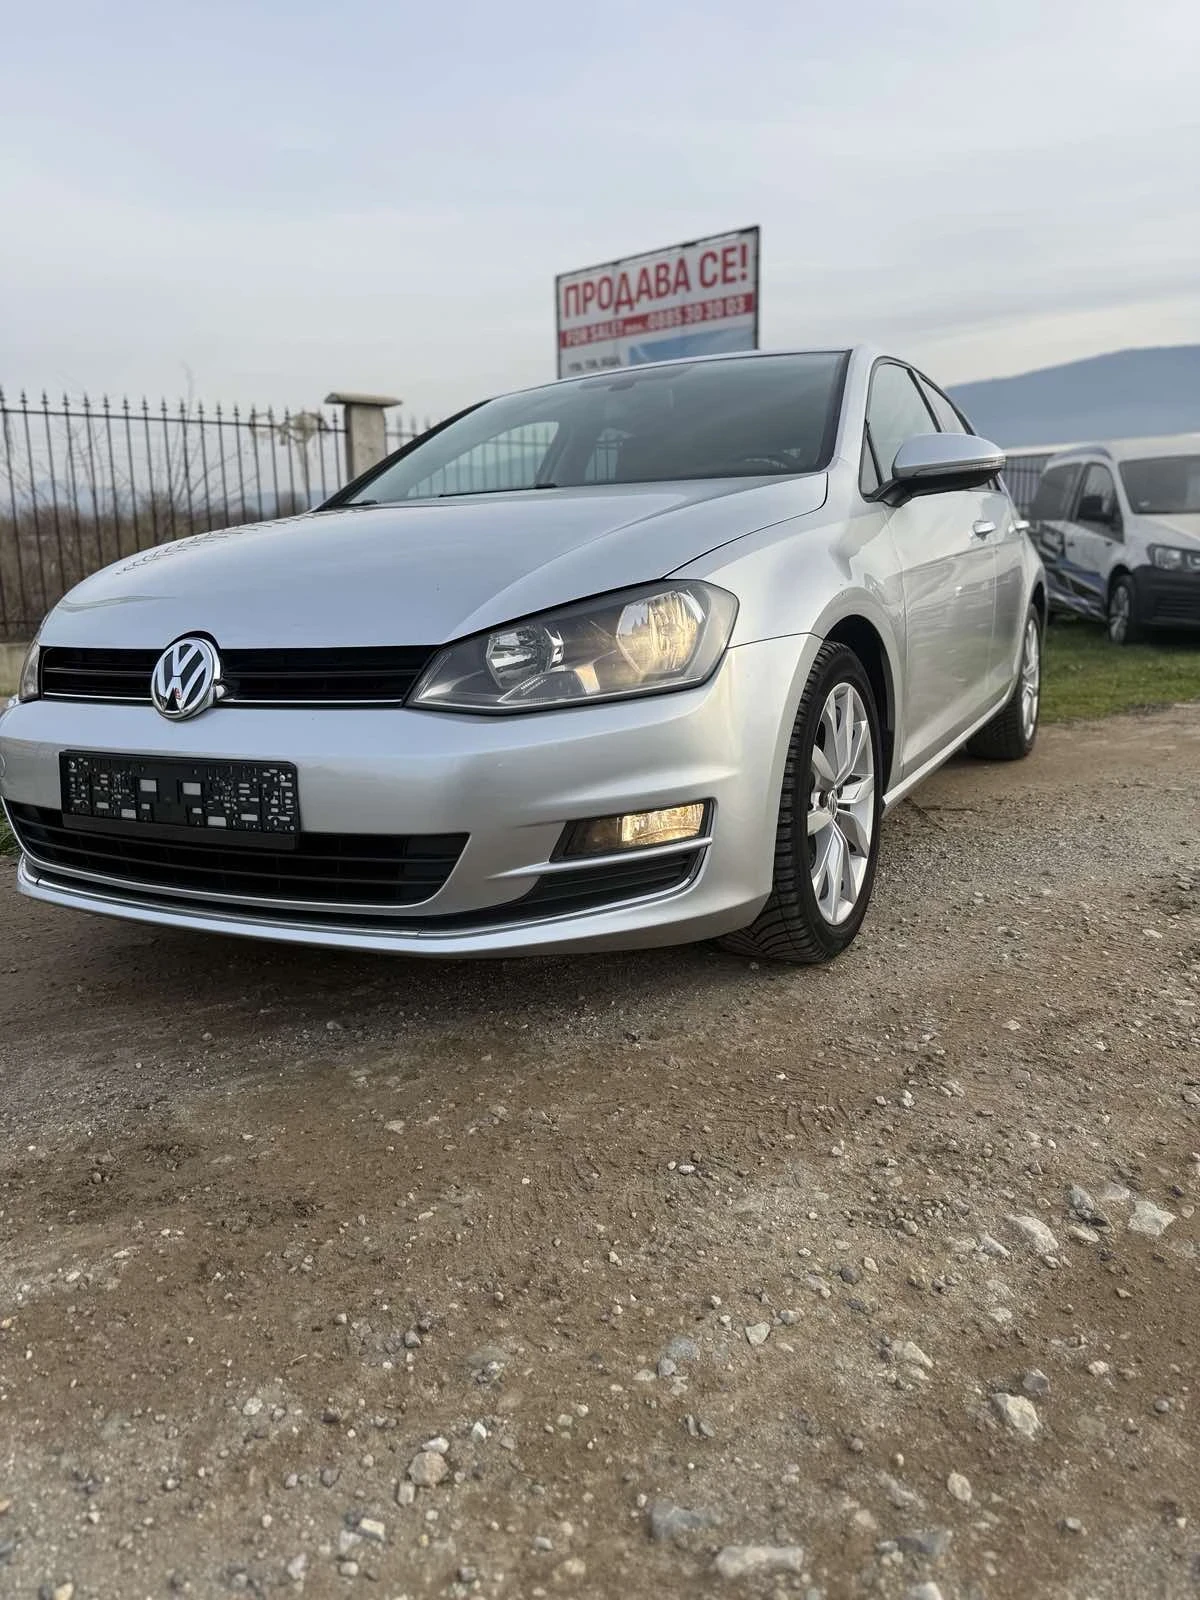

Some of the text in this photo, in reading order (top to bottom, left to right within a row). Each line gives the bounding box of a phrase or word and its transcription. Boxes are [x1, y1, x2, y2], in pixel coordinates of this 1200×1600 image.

[564, 243, 748, 319] ПРОДАВА СЕ!
[152, 638, 215, 718] VW
